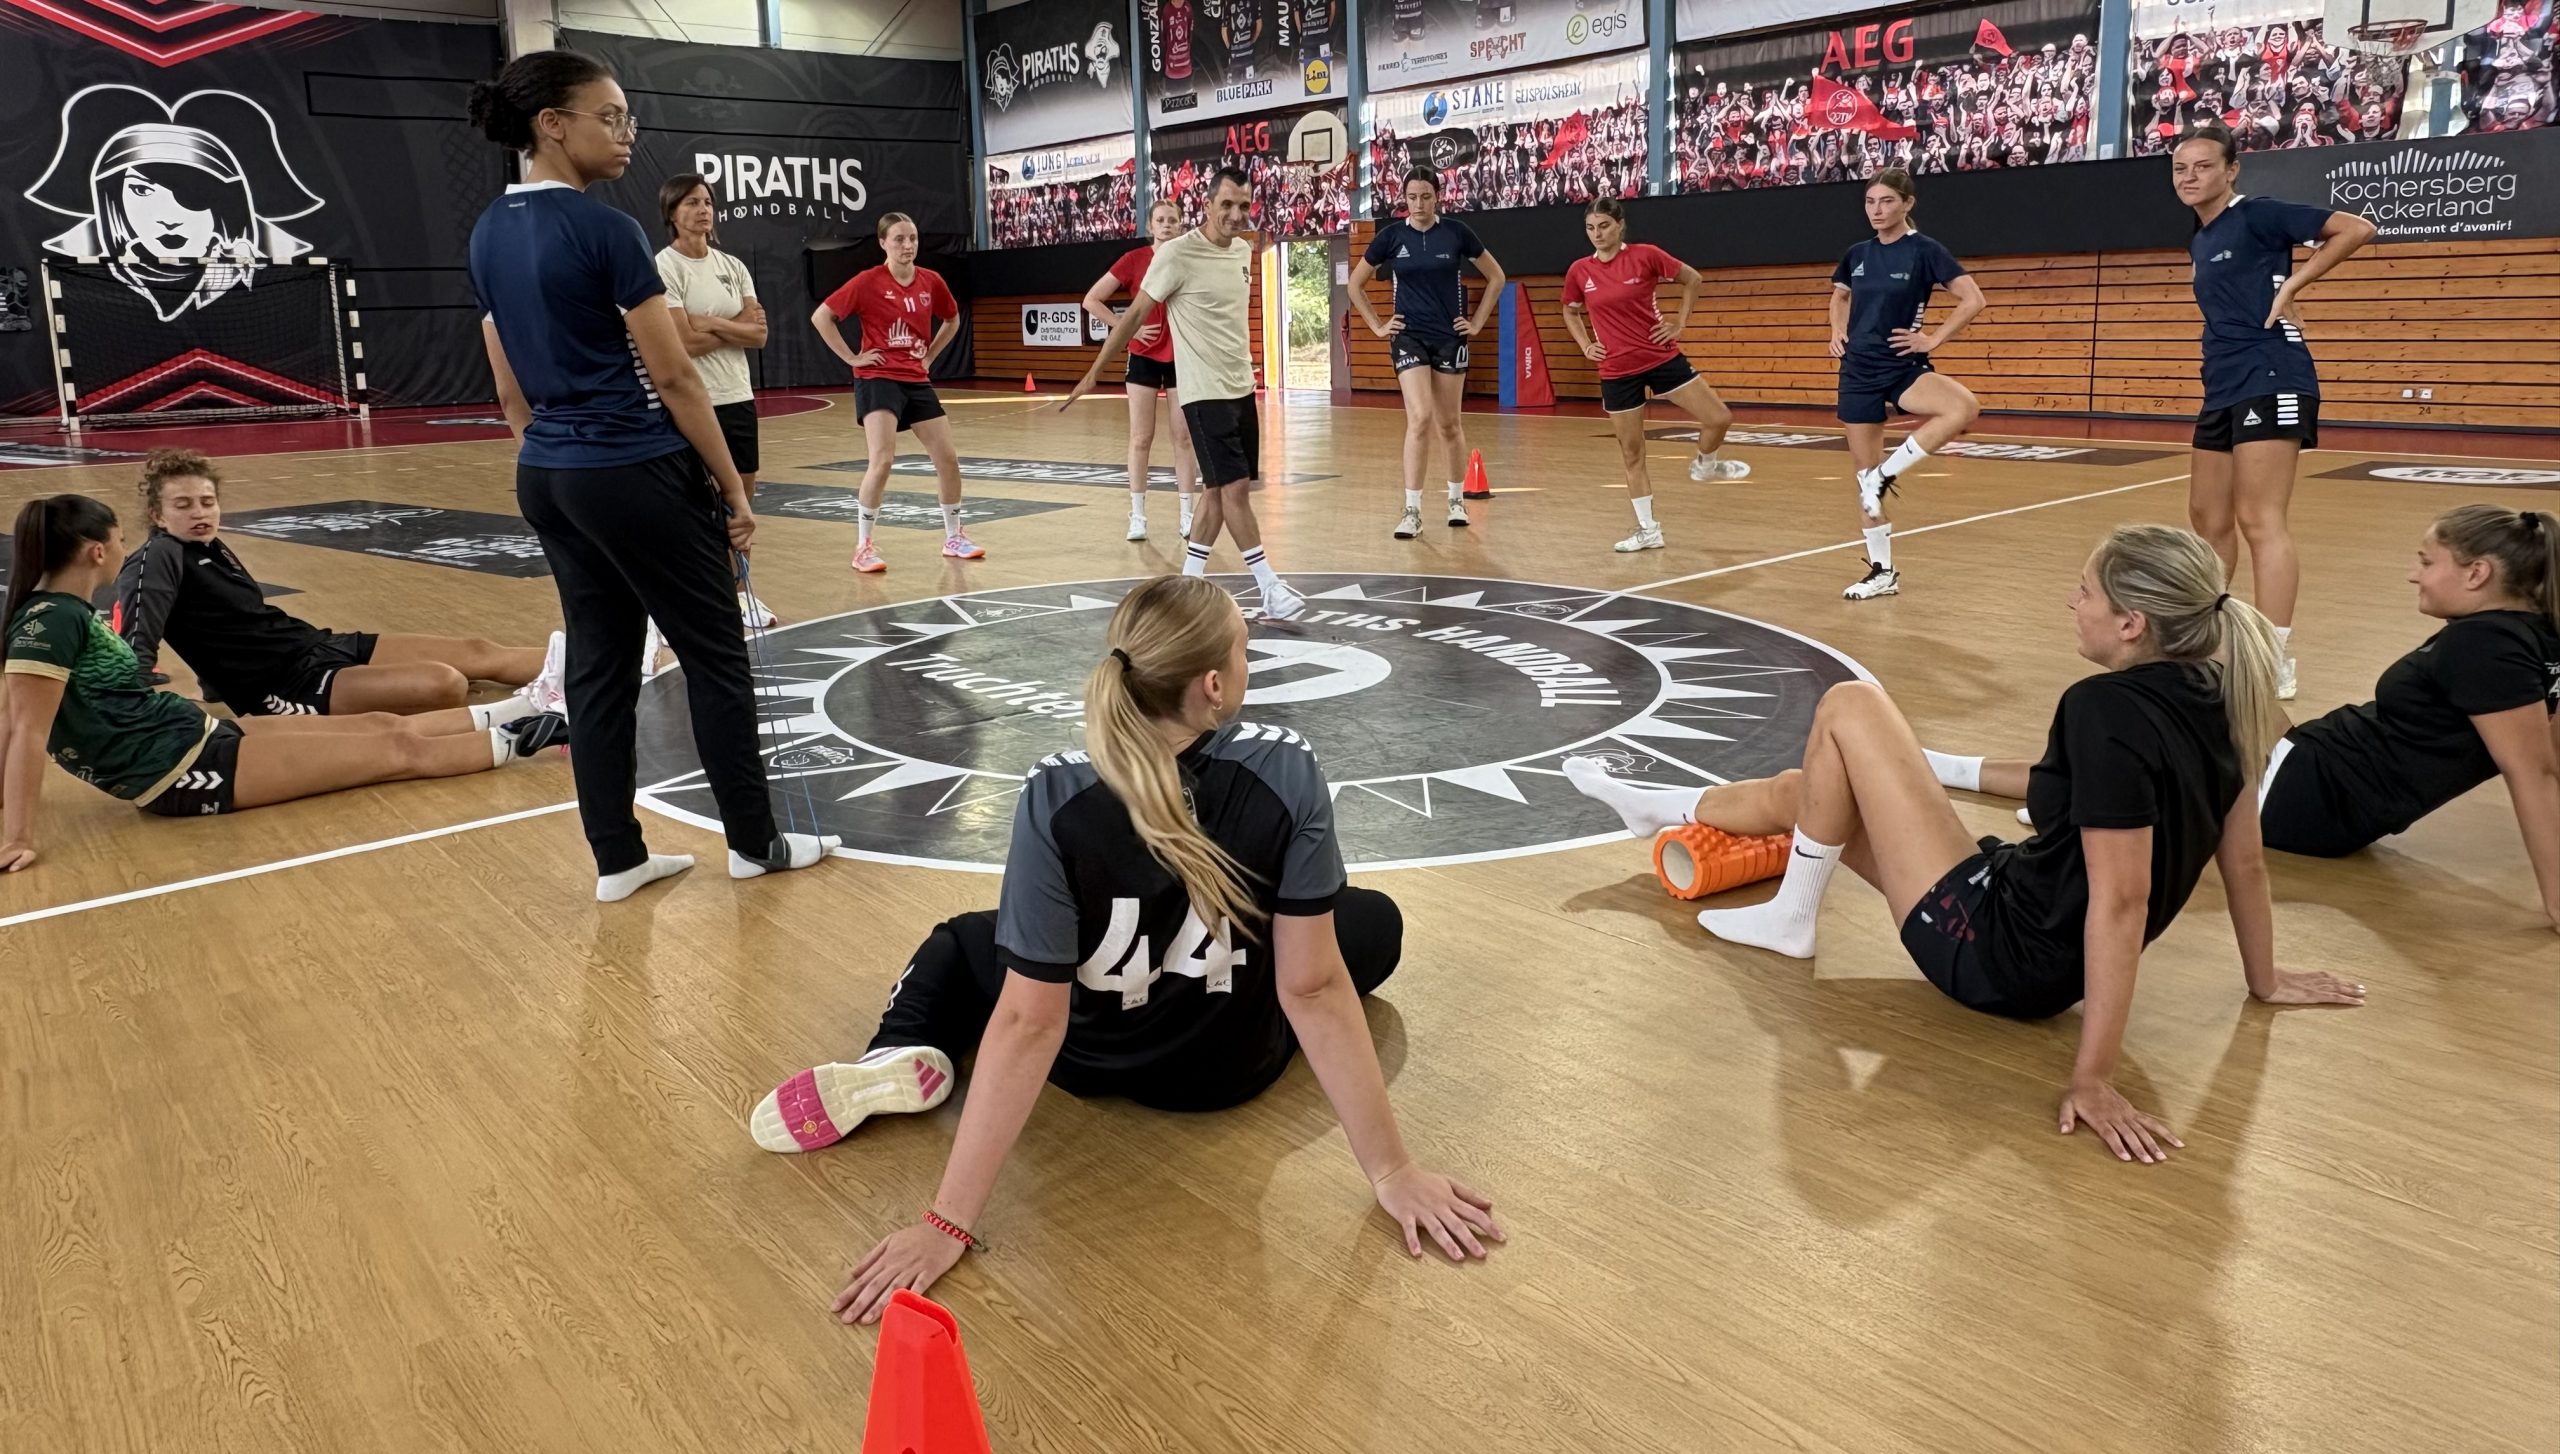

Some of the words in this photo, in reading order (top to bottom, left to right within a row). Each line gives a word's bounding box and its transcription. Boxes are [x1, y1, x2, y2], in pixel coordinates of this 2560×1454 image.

[1592, 9, 1627, 37] egis
[1470, 32, 1527, 61] SPECHT
[1821, 18, 1914, 73] AEG
[1022, 42, 1080, 86] PIRATHS
[1452, 82, 1504, 110] STANE
[1224, 121, 1271, 155] AEG
[695, 153, 867, 211] PIRATHS
[2330, 172, 2518, 205] Kochersberg
[2359, 196, 2493, 223] Ackerland
[2377, 223, 2447, 236] ésolument
[903, 297, 916, 312] 11
[1040, 311, 1076, 324] R-GDS
[2418, 406, 2432, 416] 24
[1411, 625, 1622, 708] HANDBALL
[1076, 897, 1247, 1011] 44
